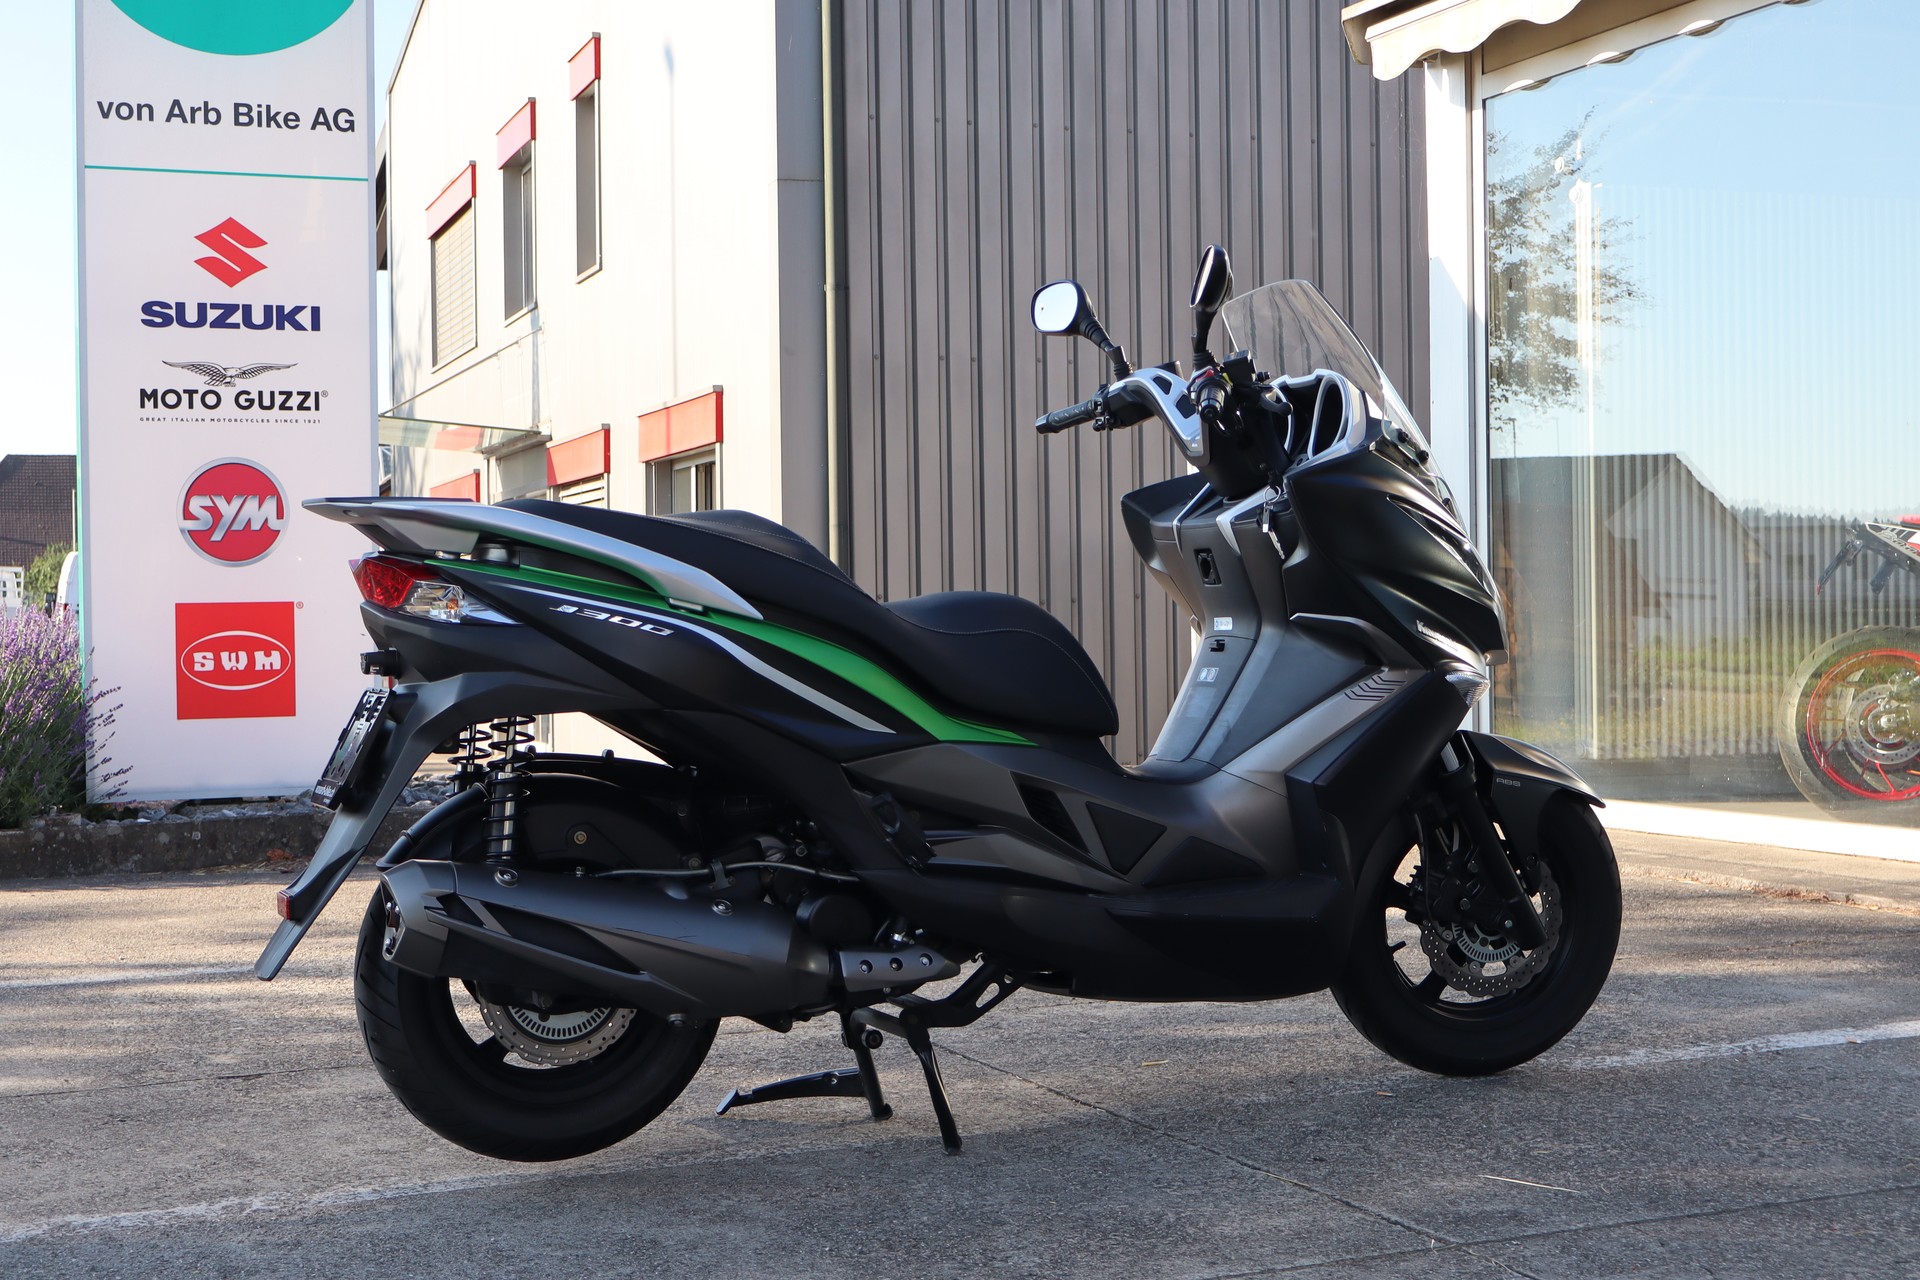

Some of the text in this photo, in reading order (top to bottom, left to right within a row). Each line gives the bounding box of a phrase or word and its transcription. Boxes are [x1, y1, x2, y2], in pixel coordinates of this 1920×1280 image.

[97, 99, 356, 133] von Arb Bike AG
[140, 300, 321, 332] SUZUKI
[139, 388, 222, 410] MOTO
[184, 495, 281, 541] SYM
[1496, 777, 1521, 787] ABS
